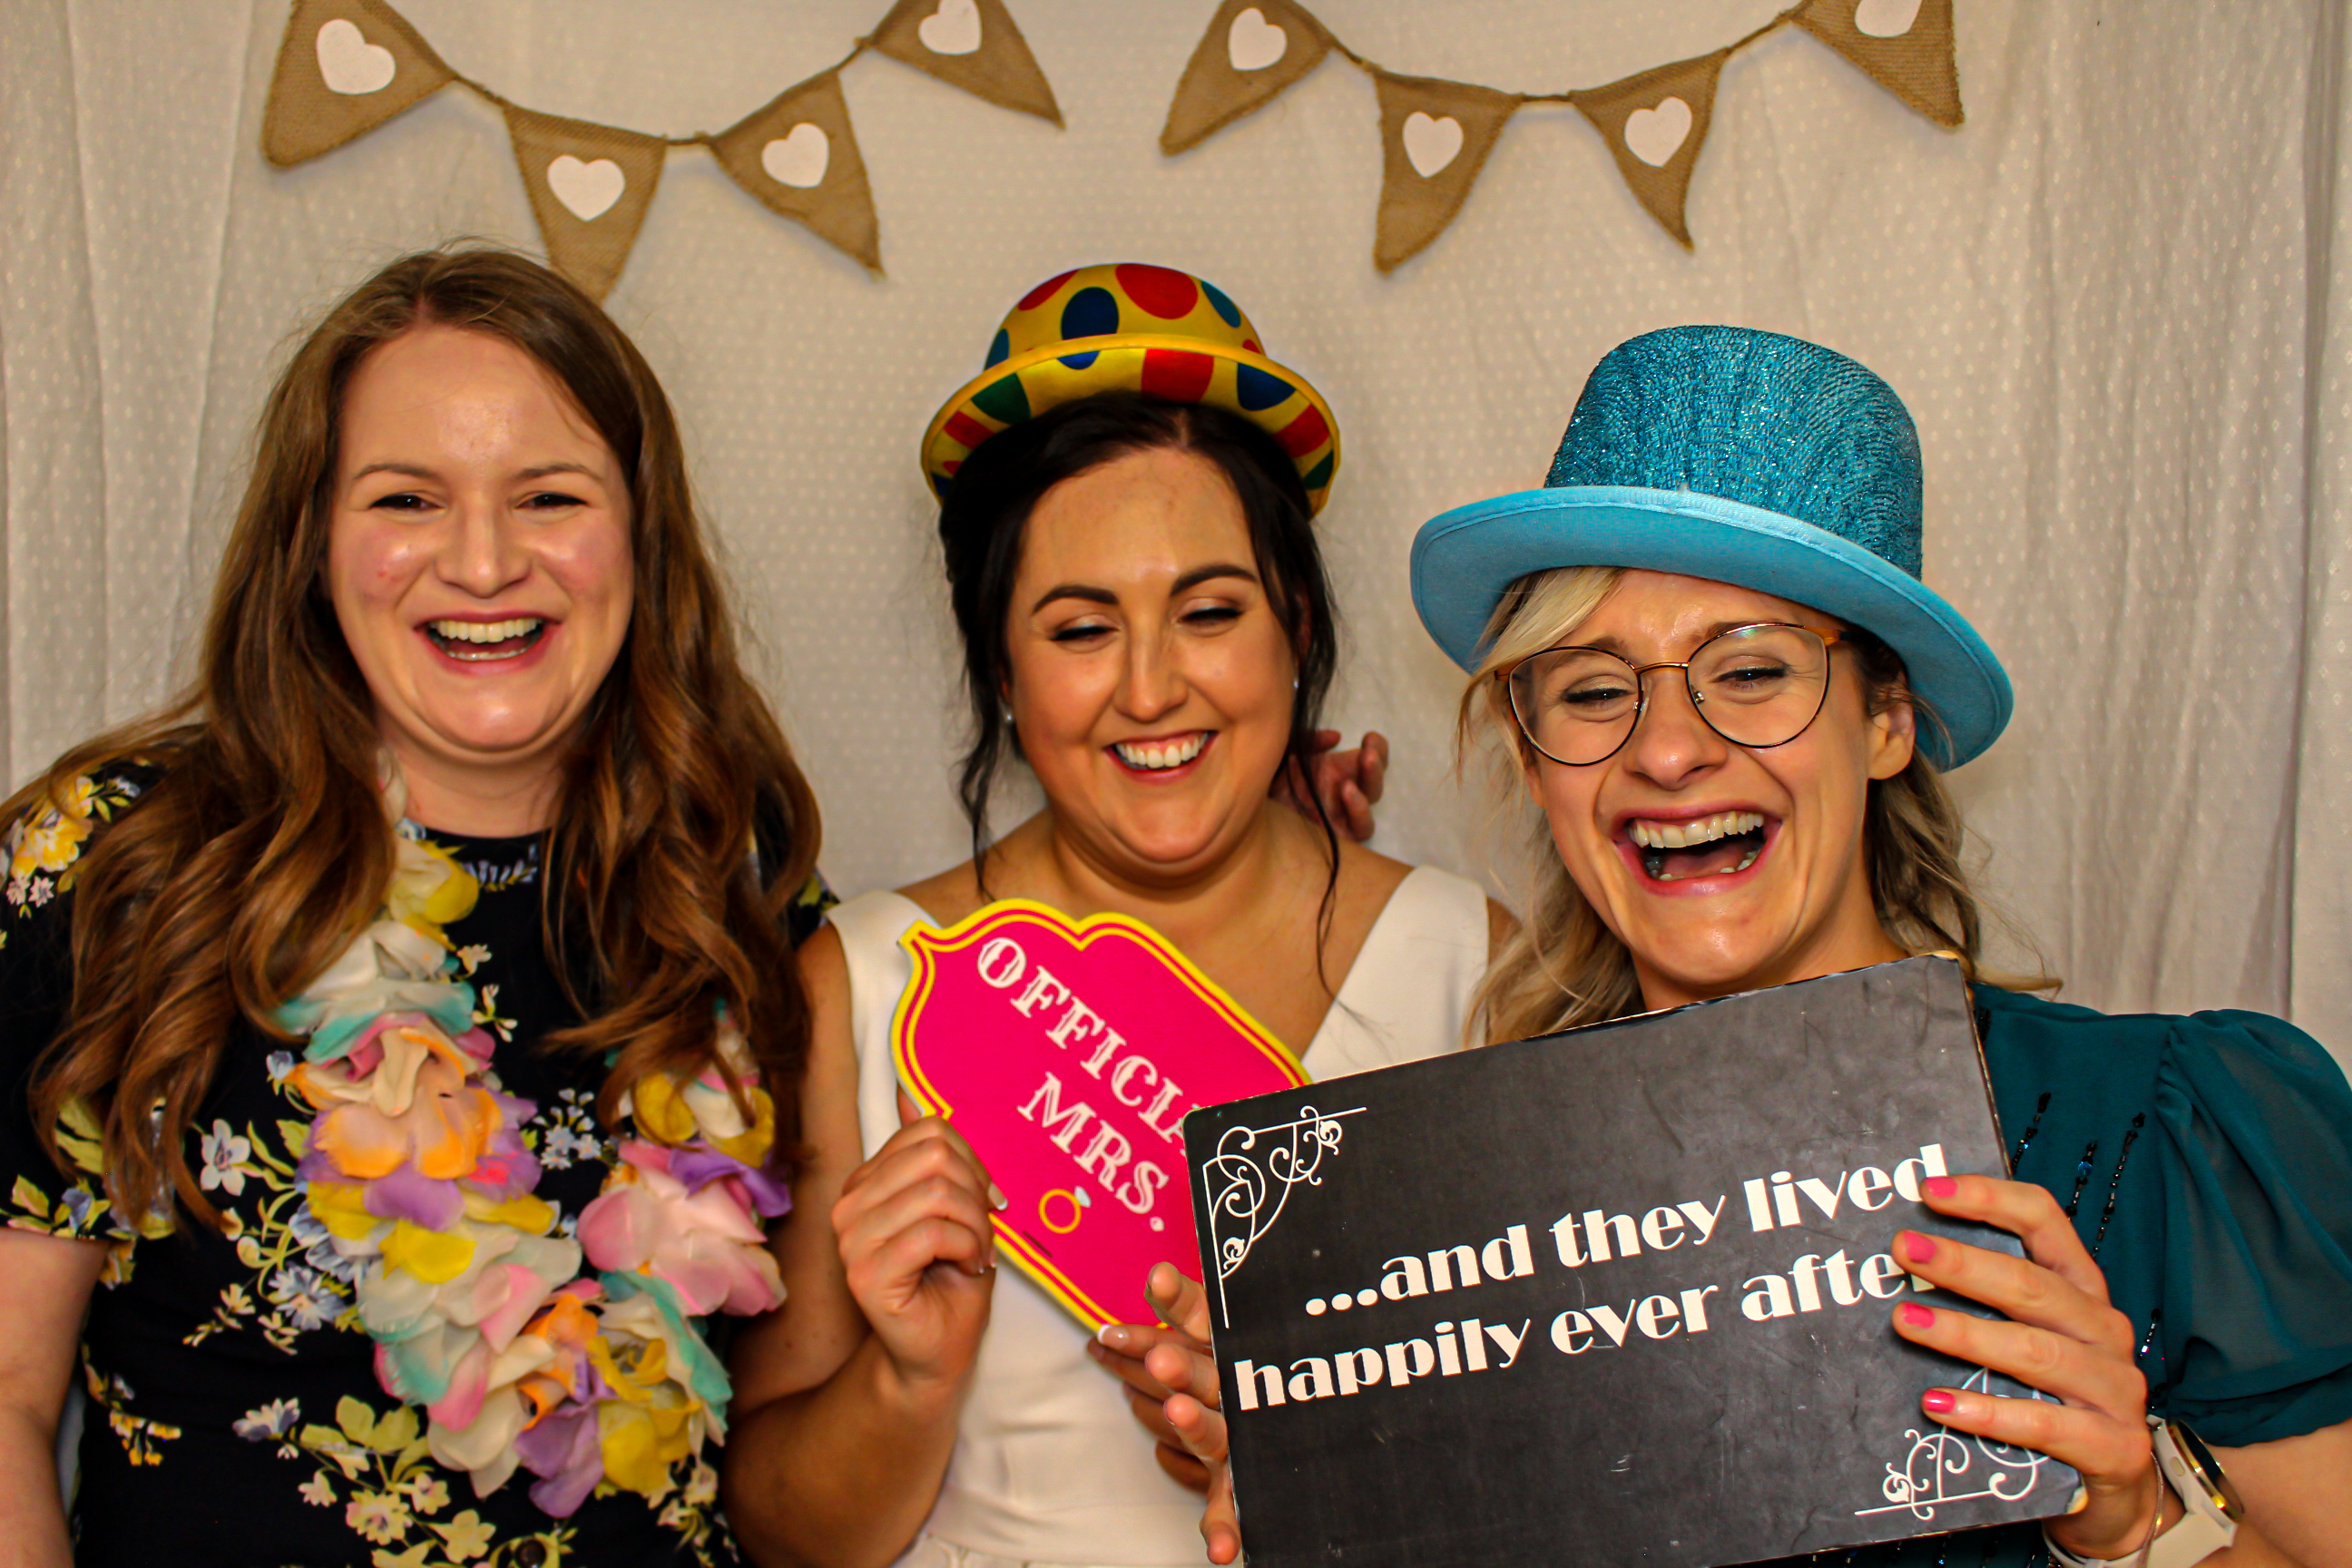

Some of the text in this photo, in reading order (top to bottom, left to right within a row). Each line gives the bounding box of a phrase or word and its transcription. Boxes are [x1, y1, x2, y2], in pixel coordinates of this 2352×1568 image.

[1017, 1072, 1170, 1232] MRS.
[1548, 1194, 1726, 1268] they
[1742, 1143, 1948, 1232] lived
[1234, 1318, 1532, 1410] happily
[1550, 1284, 1720, 1354] ever
